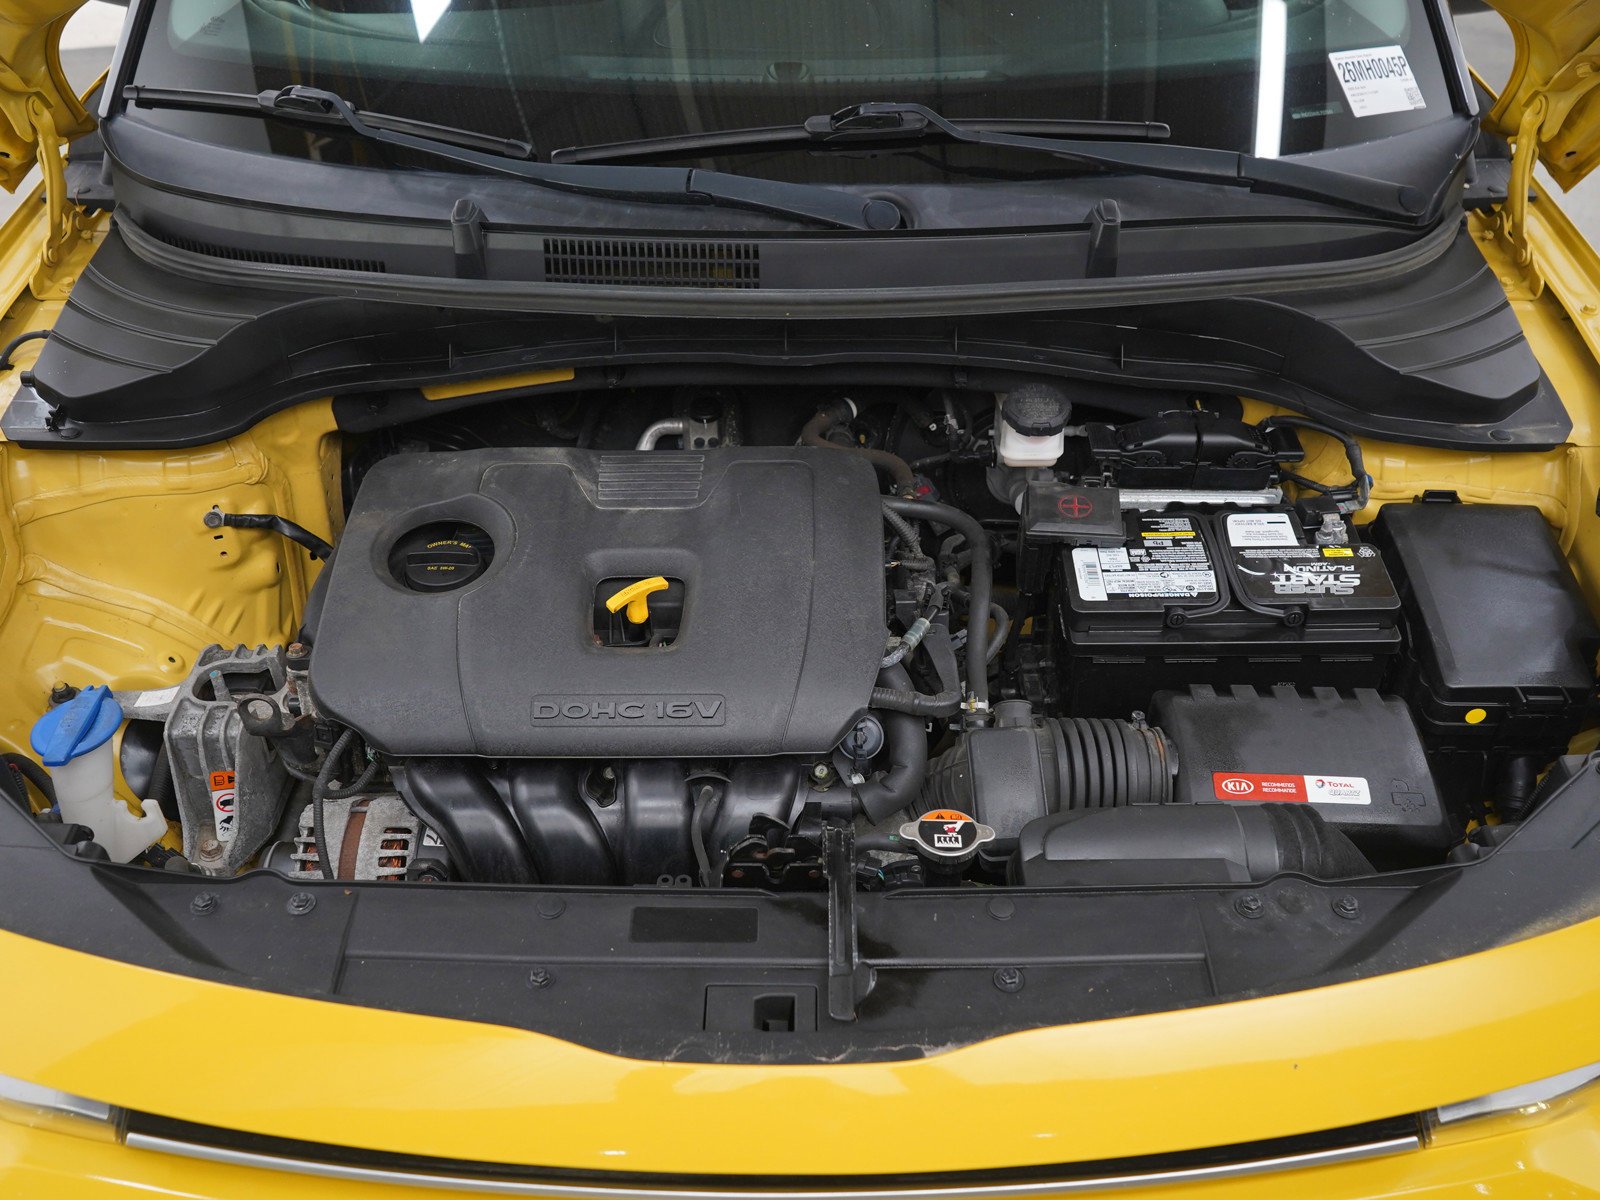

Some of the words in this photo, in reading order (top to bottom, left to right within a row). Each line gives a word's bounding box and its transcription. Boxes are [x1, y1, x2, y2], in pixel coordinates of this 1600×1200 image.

[1337, 56, 1407, 83] 26MH0045P
[427, 540, 459, 549] OWNER'S
[1271, 573, 1361, 586] START
[1274, 584, 1355, 595] SUPER
[533, 701, 646, 719] DOHC
[655, 700, 723, 719] 16V
[1225, 780, 1251, 793] KIA
[1327, 781, 1355, 789] TOTAL
